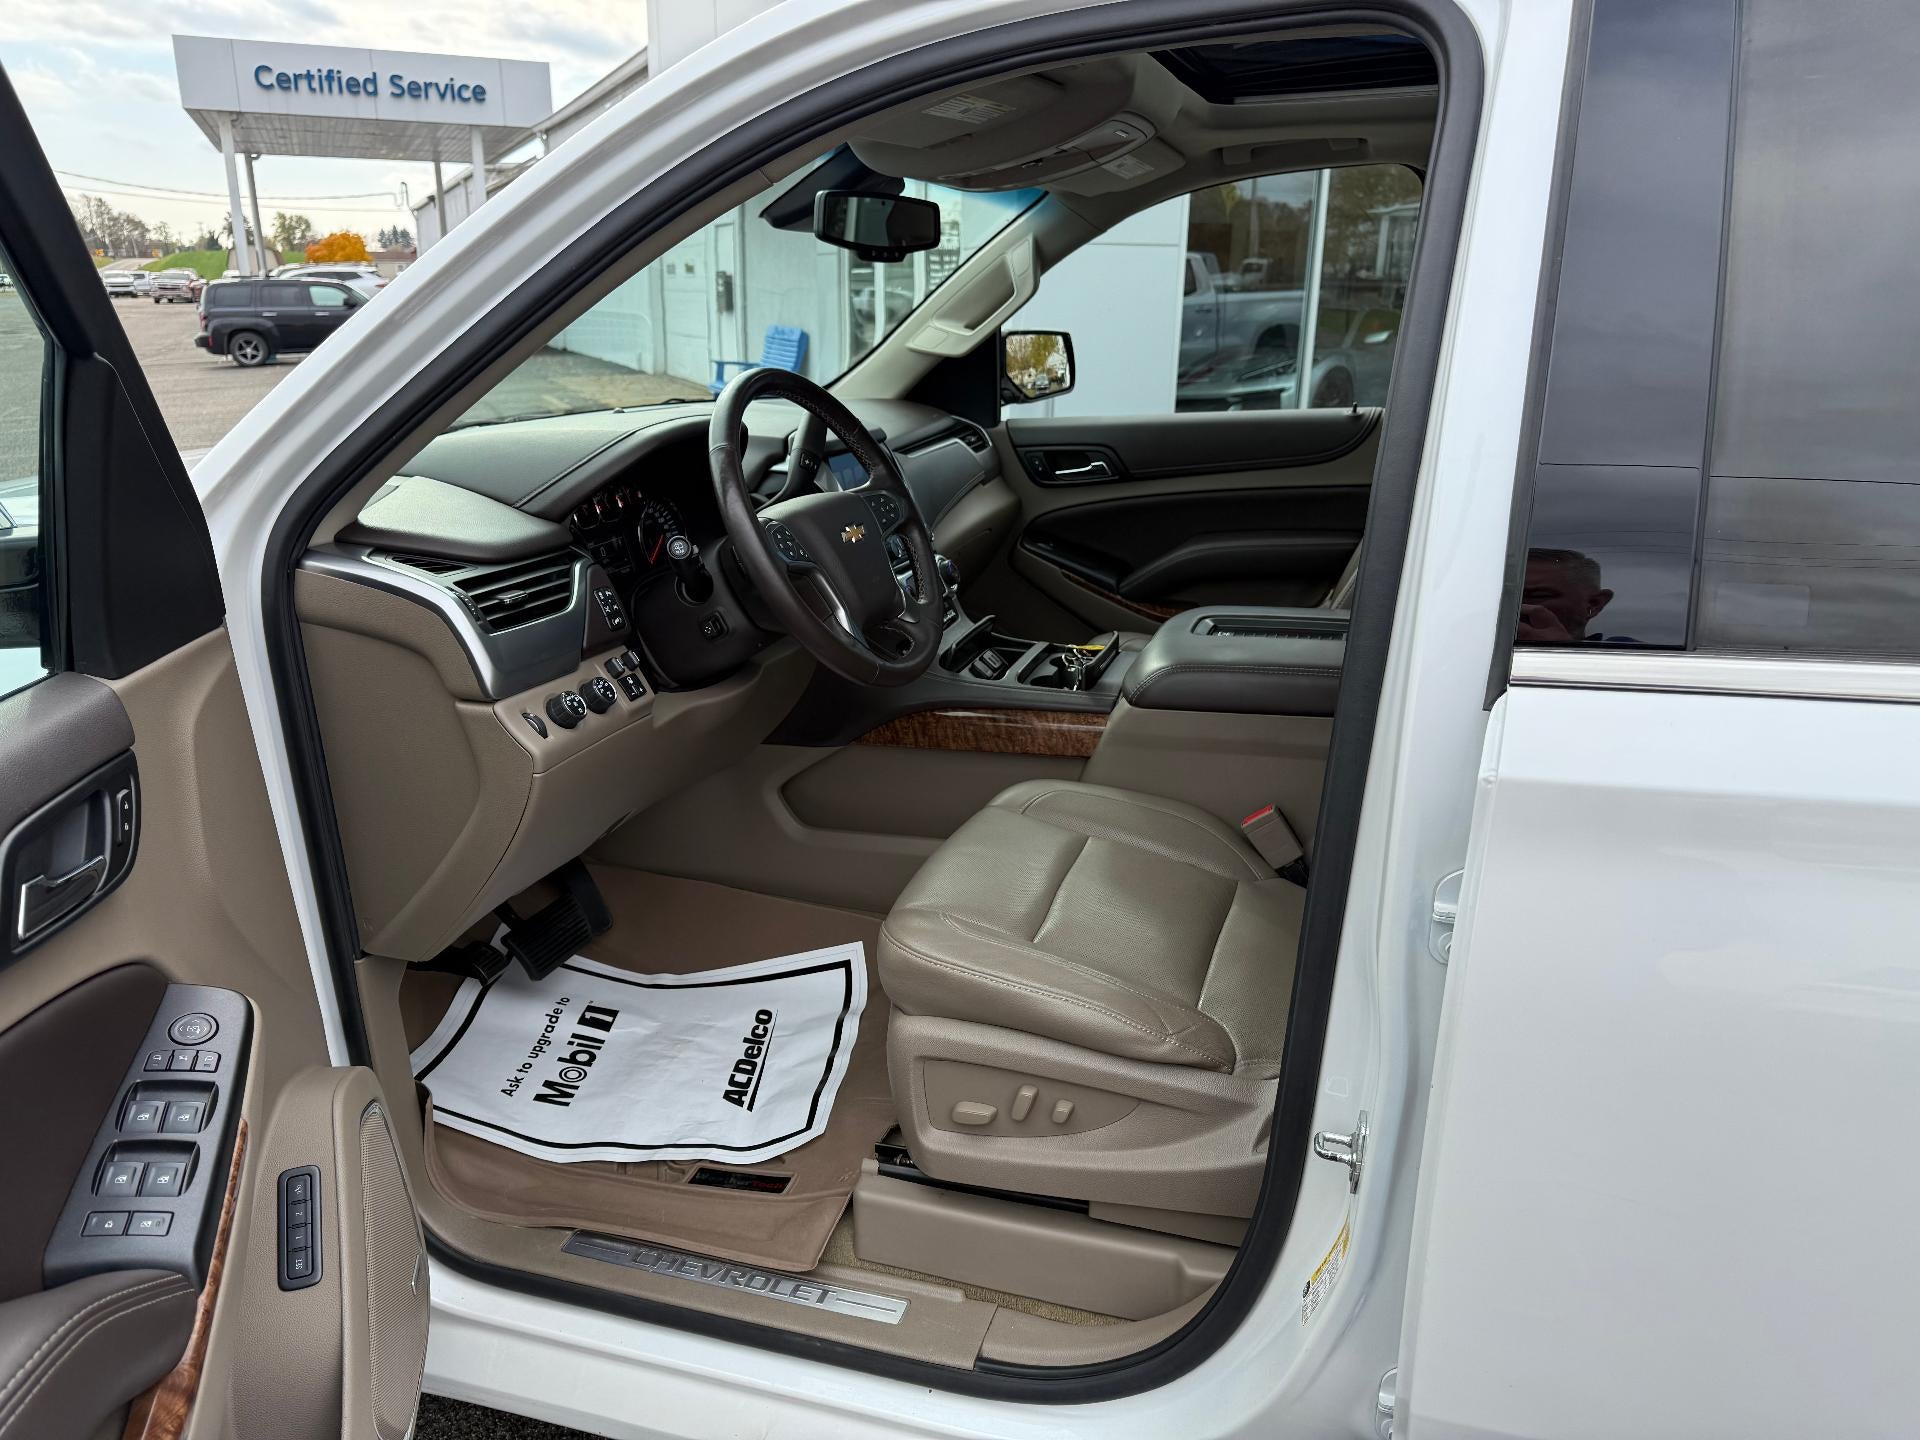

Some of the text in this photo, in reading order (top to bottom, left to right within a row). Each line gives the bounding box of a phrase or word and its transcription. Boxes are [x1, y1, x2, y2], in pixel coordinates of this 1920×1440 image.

[254, 64, 487, 103] Certified Service
[500, 996, 571, 1098] Ask to upgrade to
[532, 1032, 606, 1107] Mobil
[722, 1008, 774, 1108] ACDelco
[295, 1258, 304, 1270] SET
[632, 1249, 836, 1306] CHEVROLET
